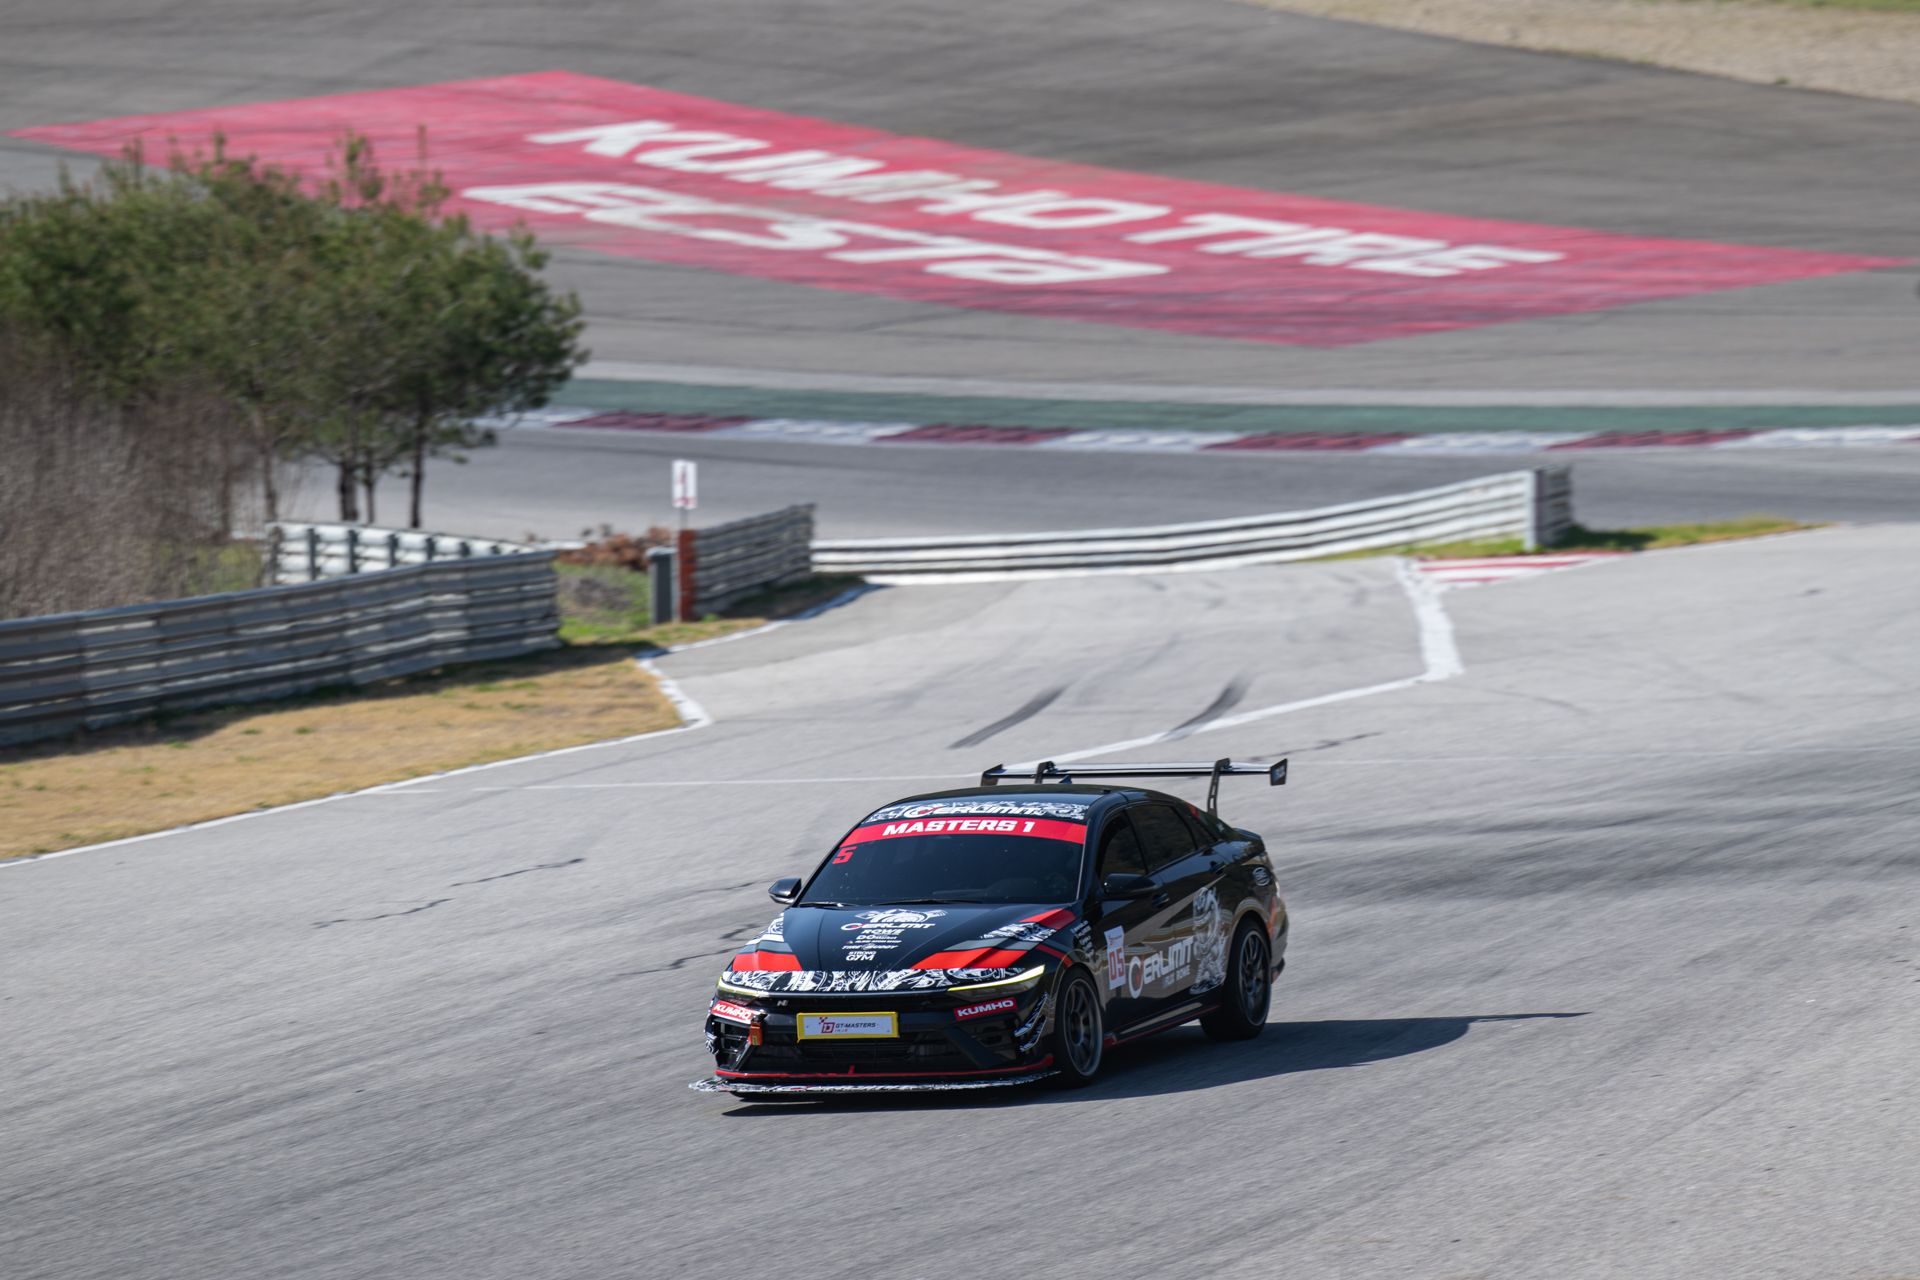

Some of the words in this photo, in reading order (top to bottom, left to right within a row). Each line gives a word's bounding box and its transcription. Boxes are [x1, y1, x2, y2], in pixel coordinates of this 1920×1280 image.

[524, 120, 1172, 229] KUMHO
[1123, 213, 1567, 277] TIRE
[882, 819, 1017, 837] MASTERS
[1022, 821, 1036, 833] 1
[831, 845, 858, 865] 5
[1108, 945, 1125, 981] 05
[713, 1003, 752, 1019] KUMHO
[957, 1000, 1014, 1017] KUMHO
